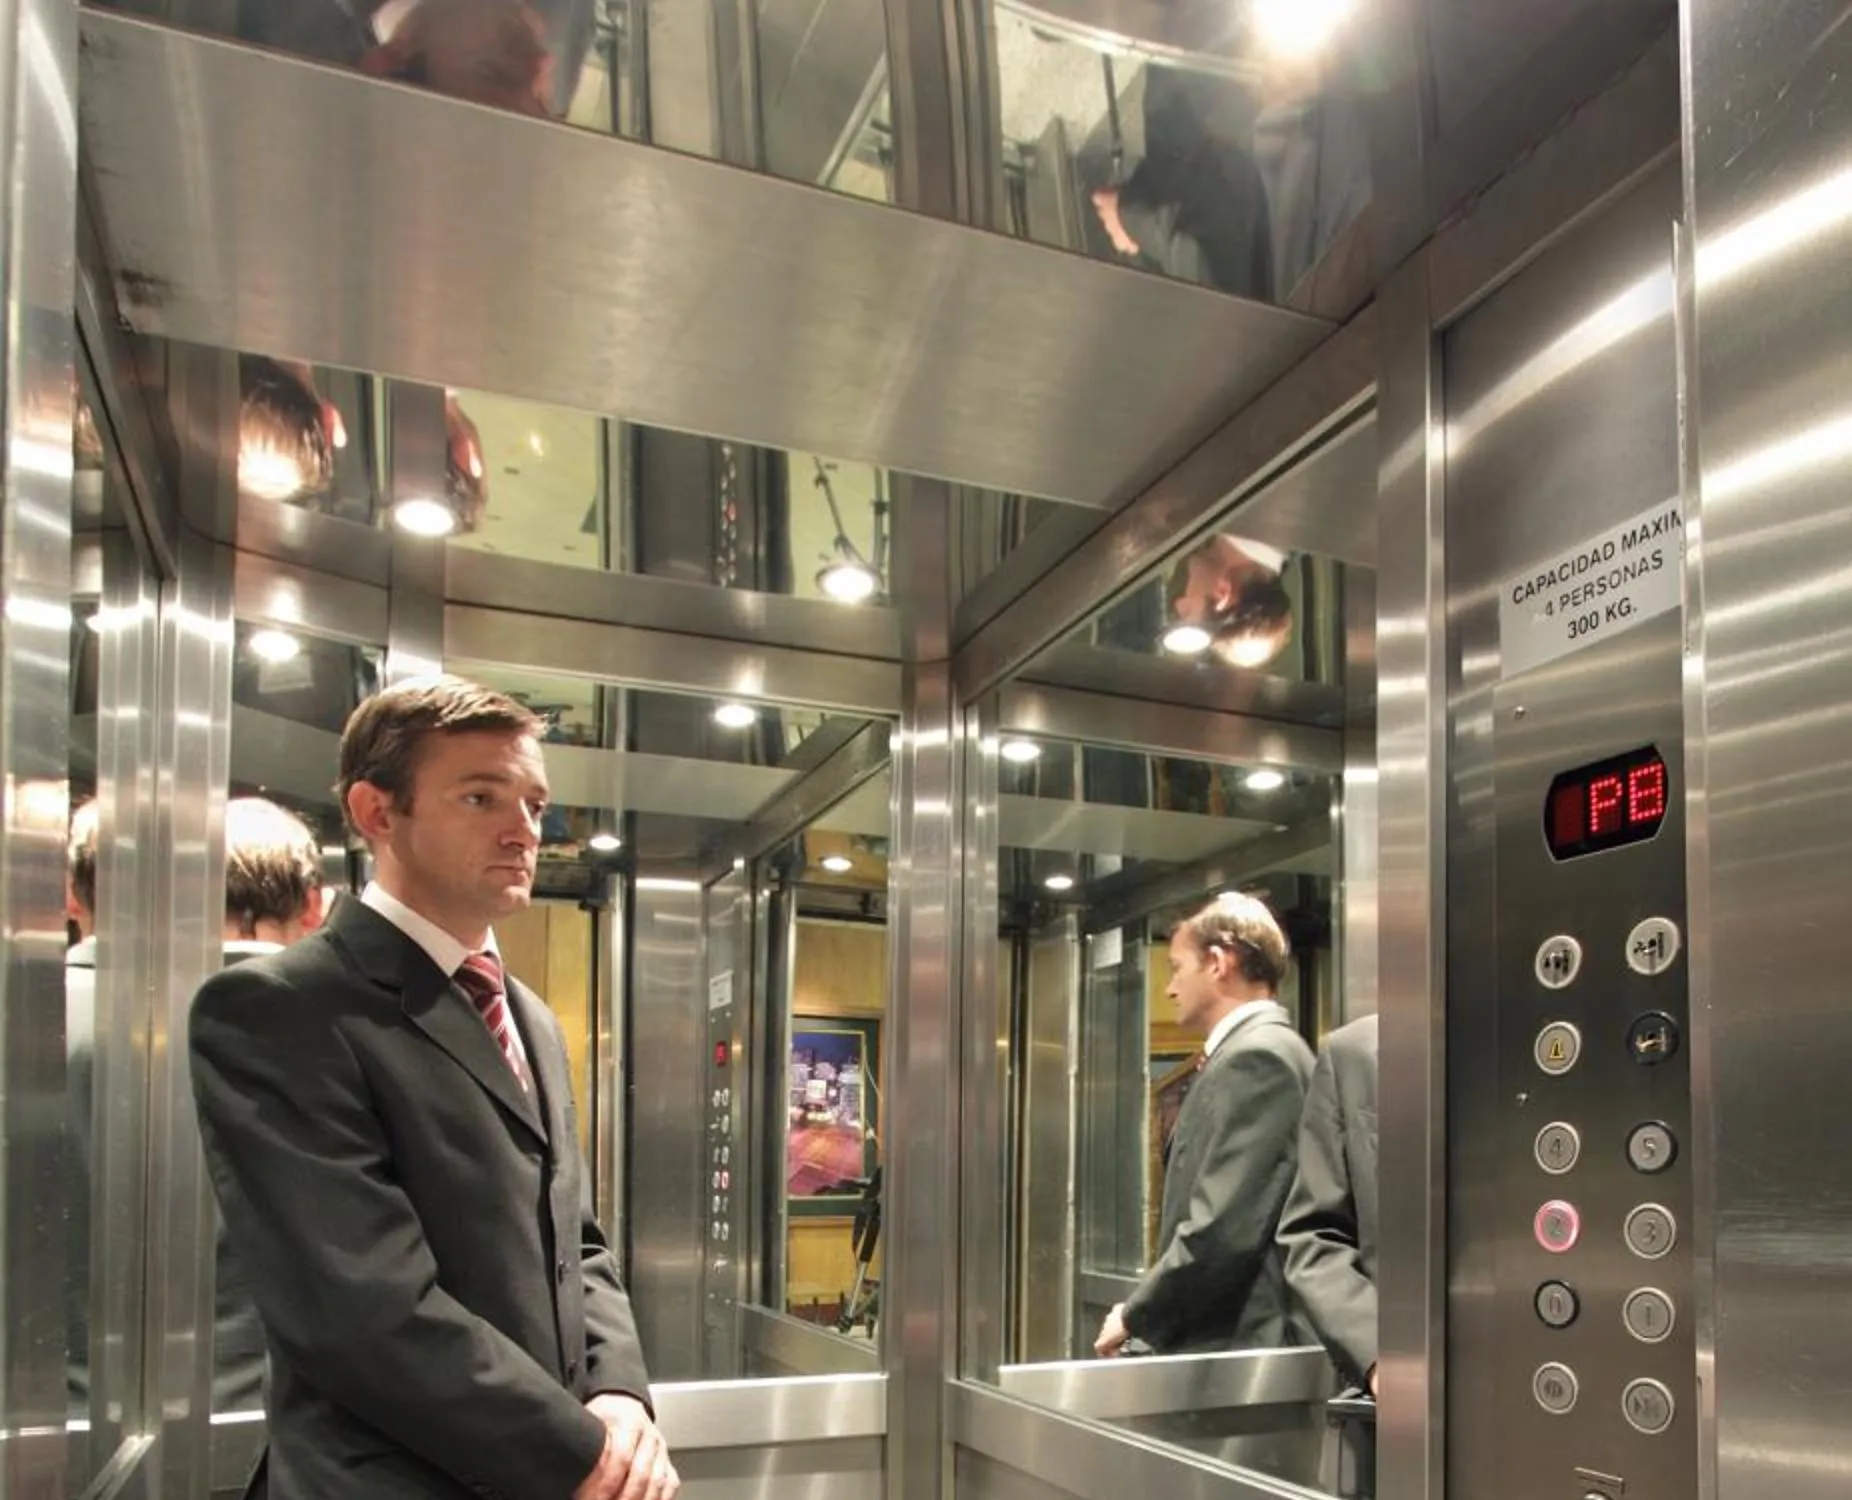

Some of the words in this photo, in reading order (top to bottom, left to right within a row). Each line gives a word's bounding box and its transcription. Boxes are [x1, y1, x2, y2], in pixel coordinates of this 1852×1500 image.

[1511, 540, 1616, 605] CAPACIDAD
[1559, 549, 1664, 613] PERSONAS
[1567, 611, 1600, 640] 300
[1605, 597, 1638, 623] KG.
